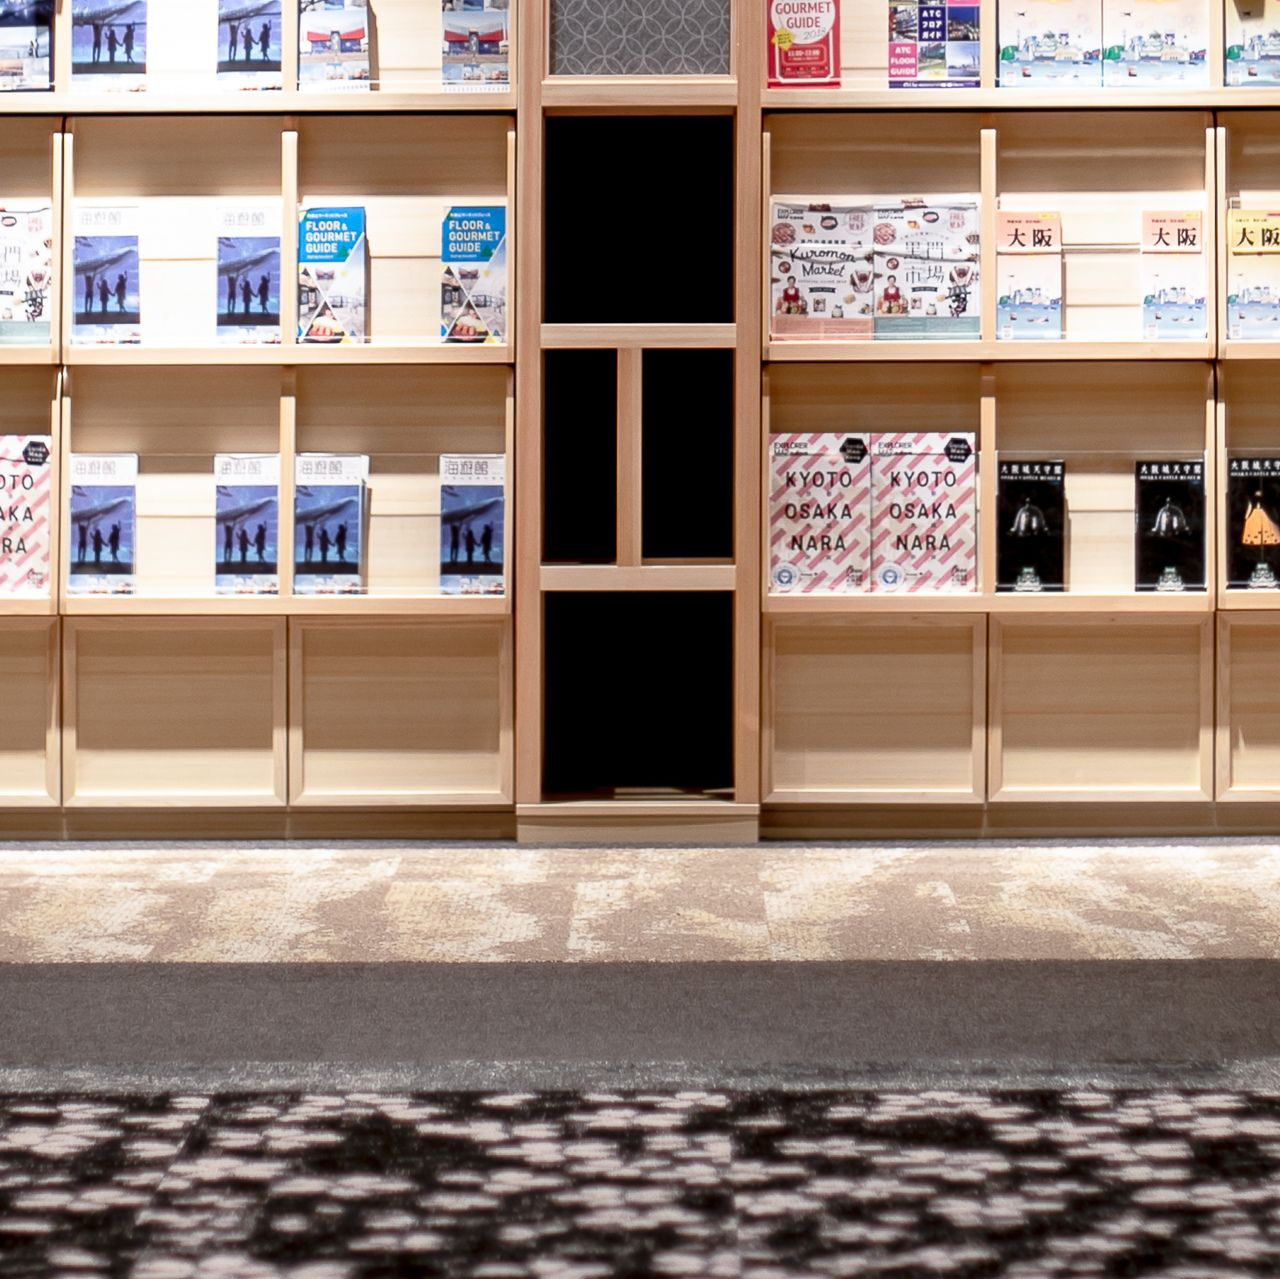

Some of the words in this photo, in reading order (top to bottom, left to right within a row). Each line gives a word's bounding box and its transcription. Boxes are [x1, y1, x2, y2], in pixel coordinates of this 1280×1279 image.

[775, 1, 832, 15] GOURMET
[922, 10, 941, 18] ATC
[786, 16, 821, 29] GUIDE
[922, 31, 942, 39] ガイド
[895, 46, 911, 54] ATC
[890, 68, 916, 76] GUIDE
[305, 220, 341, 231] FLOOR
[341, 222, 348, 231] &
[449, 220, 484, 230] FLOOR
[485, 222, 491, 230] &
[305, 231, 357, 242] GOURMET
[448, 231, 500, 241] GOURMET
[1007, 228, 1053, 247] 大阪
[1151, 227, 1197, 247] 大阪
[1236, 227, 1280, 246] 大阪
[305, 243, 338, 253] GUIDE
[448, 242, 481, 252] GUIDE
[790, 246, 857, 263] Kuromon
[802, 262, 846, 278] Market
[785, 471, 852, 488] KYOTO
[890, 471, 956, 487] KYOTO
[784, 503, 852, 520] OSAKA
[889, 503, 957, 520] OSAKA
[790, 534, 846, 551] NARA
[895, 534, 951, 551] NARA
